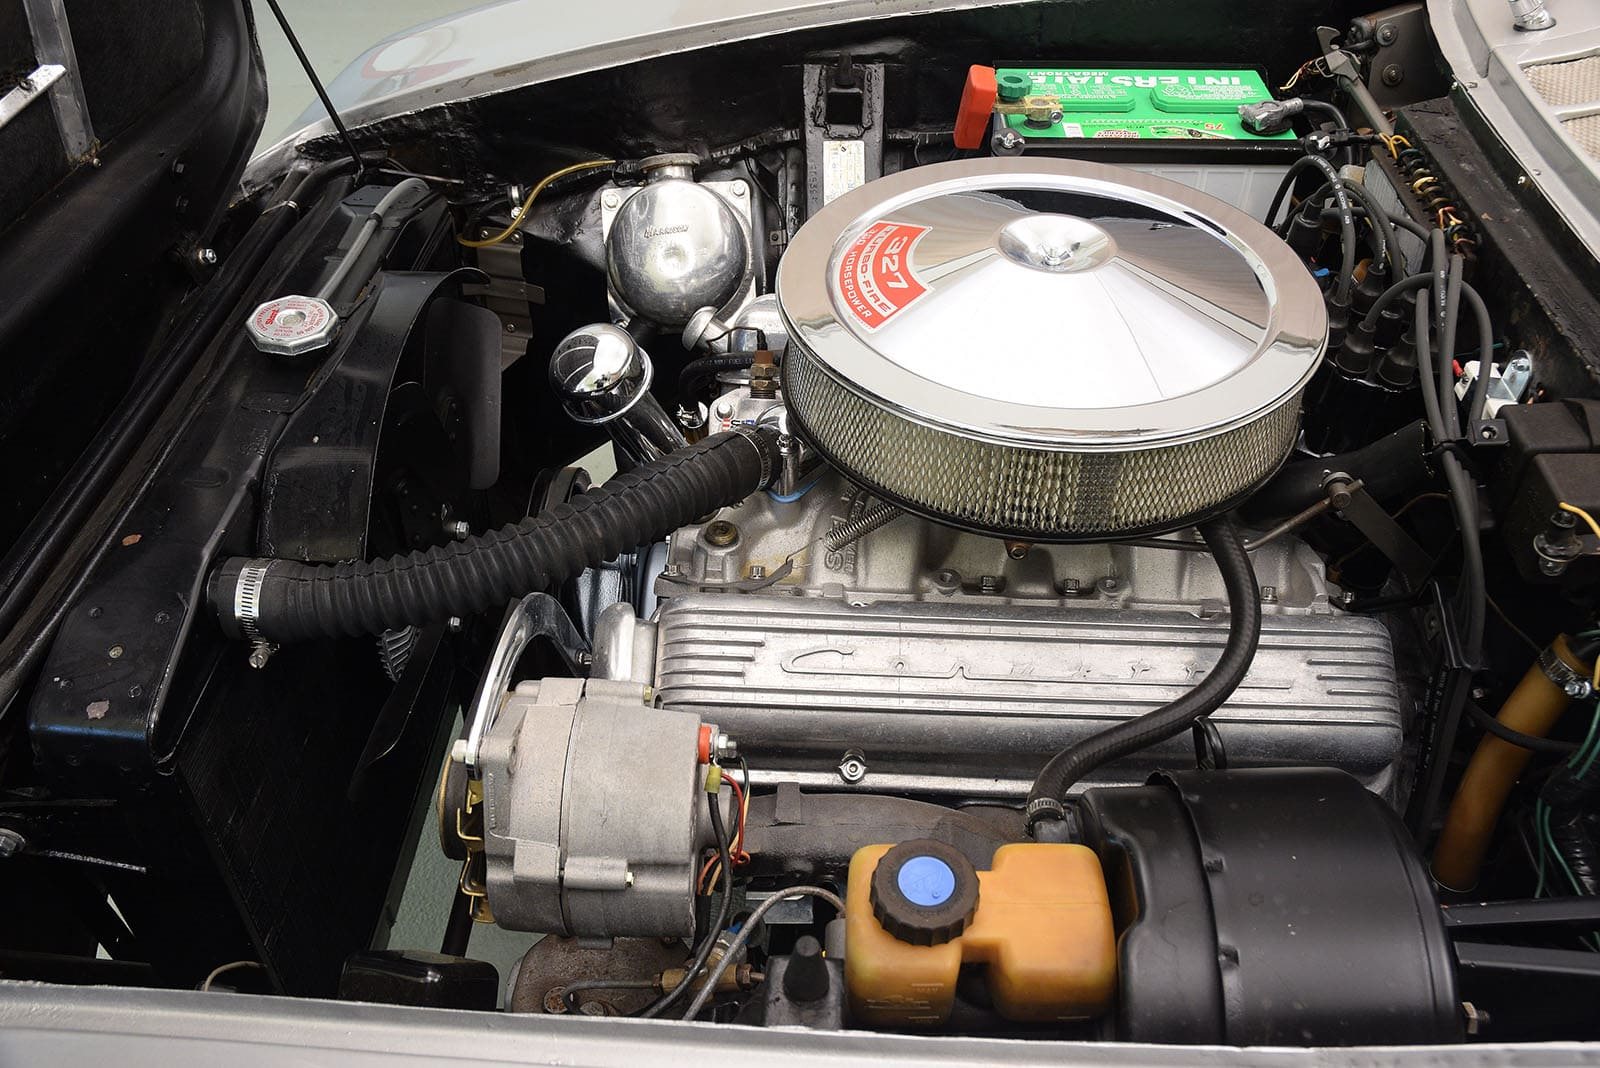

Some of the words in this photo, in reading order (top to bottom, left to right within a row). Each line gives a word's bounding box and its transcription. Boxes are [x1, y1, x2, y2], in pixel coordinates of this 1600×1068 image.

[1031, 76, 1240, 88] INTERSTATE
[1204, 122, 1223, 130] 75
[843, 250, 873, 318] HORSEPOWER
[860, 227, 892, 313] TURBO-FIRE
[881, 236, 910, 289] 327
